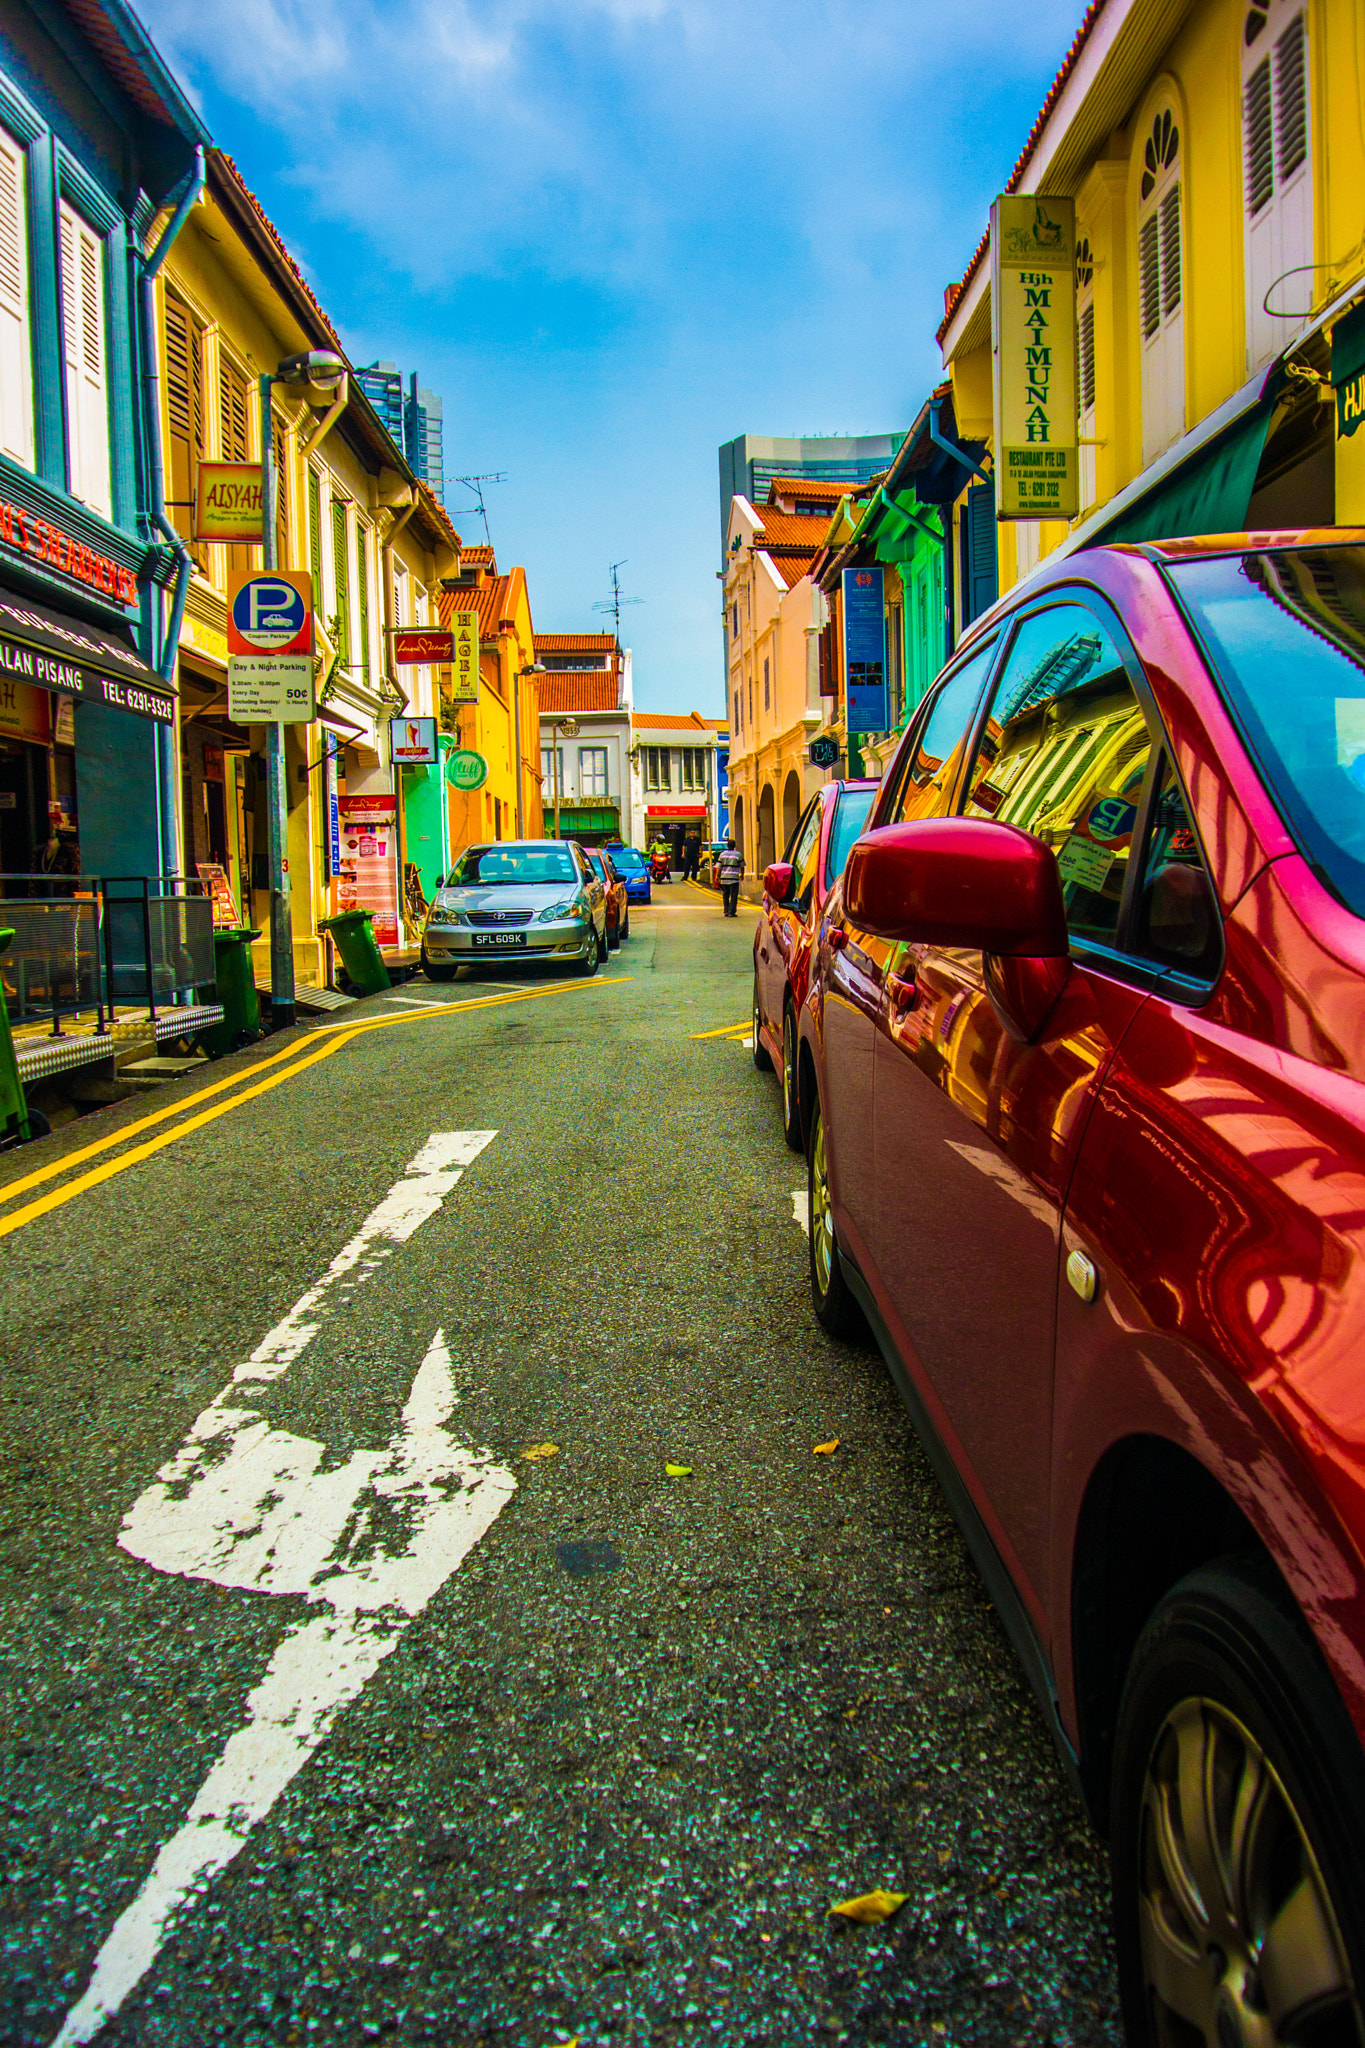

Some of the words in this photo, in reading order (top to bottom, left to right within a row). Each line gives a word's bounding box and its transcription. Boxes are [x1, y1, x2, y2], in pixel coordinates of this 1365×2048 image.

[1019, 272, 1053, 286] Hjh
[1024, 288, 1053, 442] MAIMUNAH
[1009, 451, 1043, 466] RESTAURANT
[1045, 451, 1055, 467] PTE
[1056, 452, 1066, 467] LTD
[1018, 481, 1027, 496] TEL
[1033, 481, 1045, 496] 6291
[206, 484, 263, 510] AISYAH
[35, 518, 139, 608] STEAKHOUSE
[250, 584, 296, 629] P
[458, 614, 471, 687] HAGEL
[233, 663, 248, 671] Day
[250, 663, 256, 671] &
[258, 663, 277, 672] Night
[280, 663, 307, 672] Parking
[36, 656, 84, 691] PISANG
[101, 679, 126, 704] TEL:
[127, 688, 172, 719] 6291-3326
[232, 689, 248, 697] Every
[249, 689, 260, 697] Day
[286, 689, 308, 699] 50¢
[814, 743, 834, 752] THE
[815, 751, 834, 761] LAB
[580, 796, 614, 807] AROMATICS
[282, 858, 289, 873] 3
[476, 934, 521, 944] SFL609K
